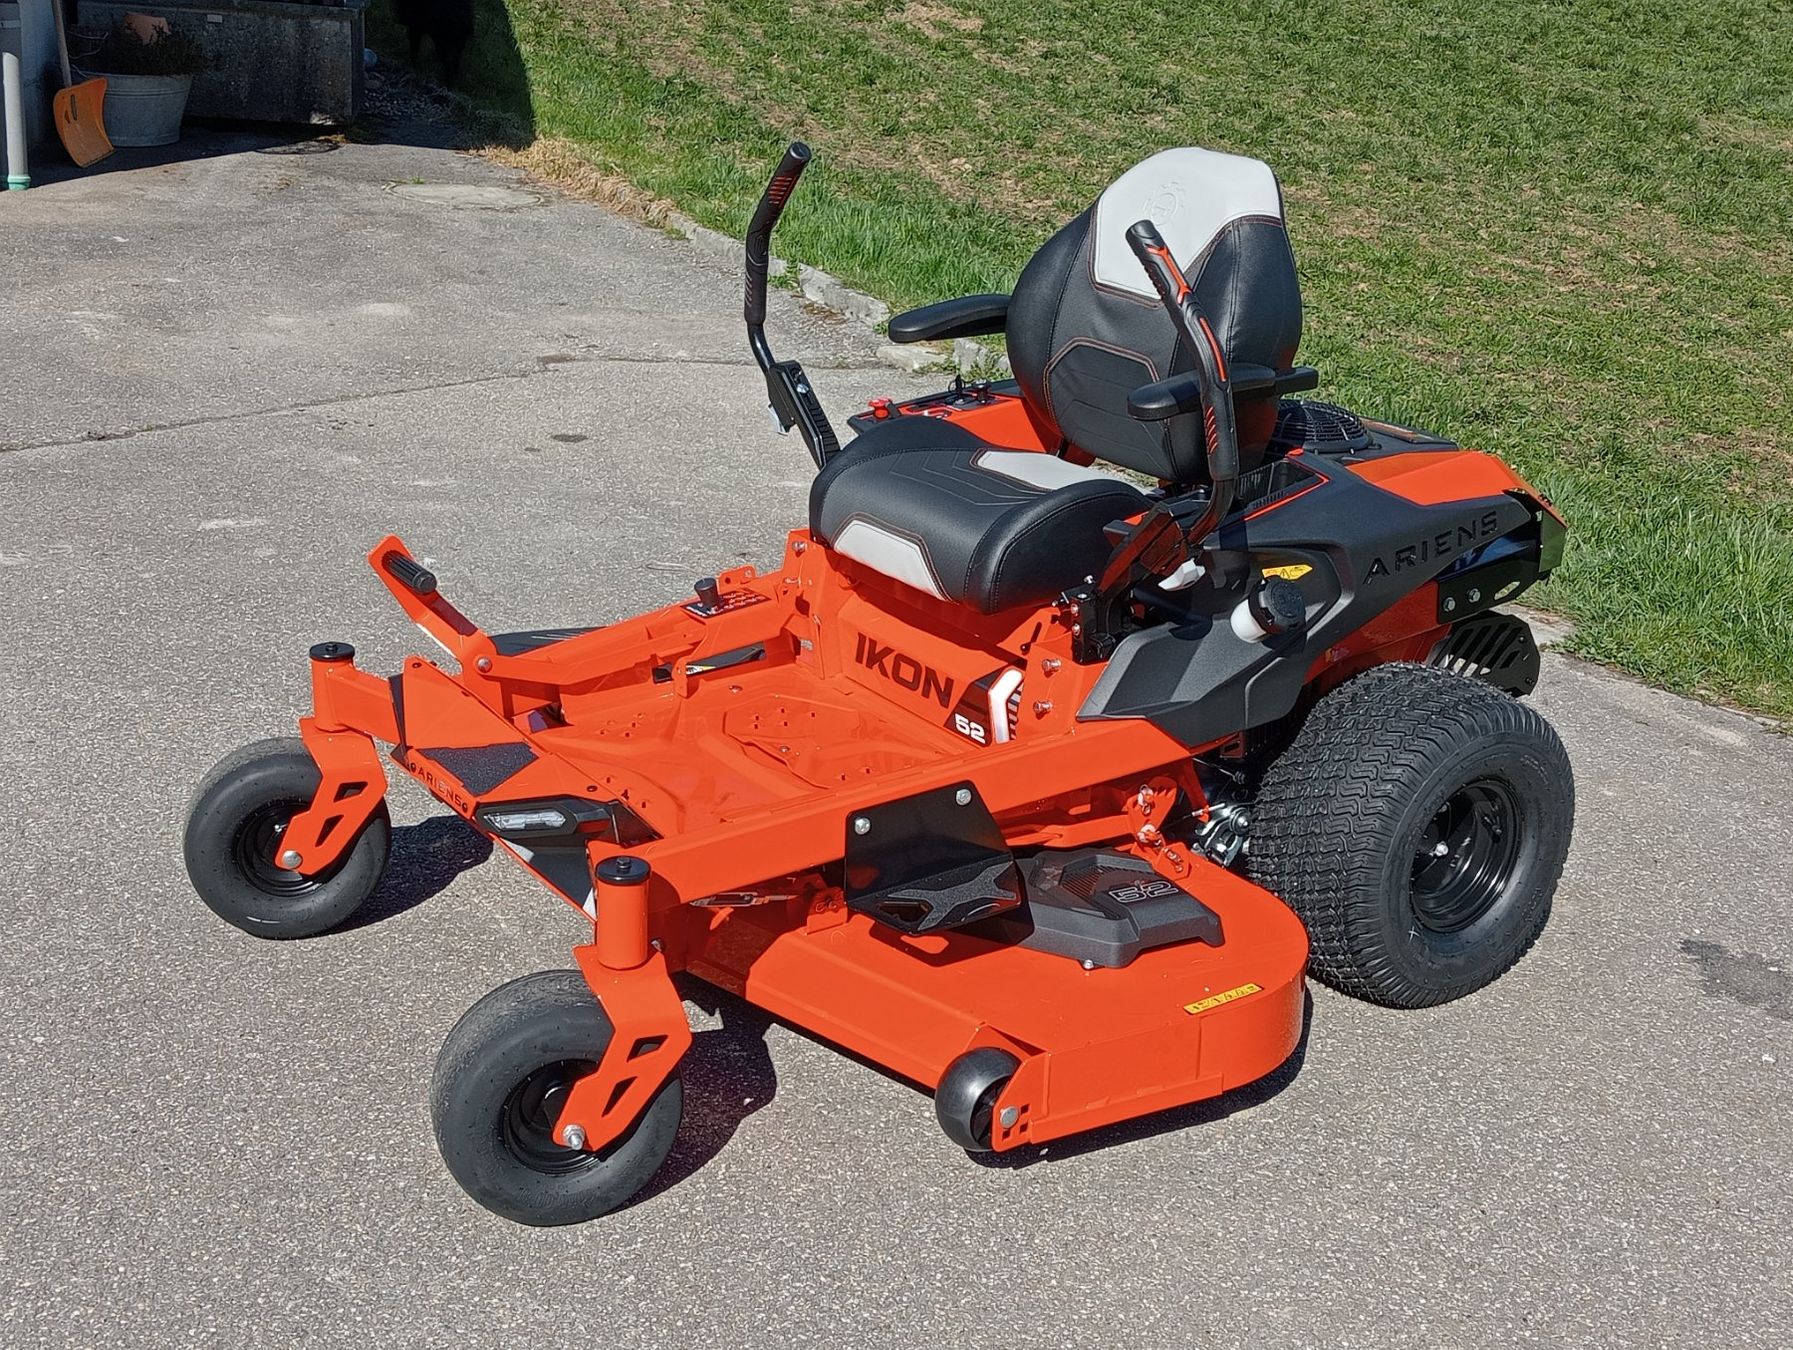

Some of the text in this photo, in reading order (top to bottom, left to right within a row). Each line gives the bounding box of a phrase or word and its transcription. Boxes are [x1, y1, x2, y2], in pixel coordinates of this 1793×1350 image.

[1363, 510, 1497, 585] ARIENS
[855, 632, 954, 709] IKON
[955, 713, 986, 744] 52
[418, 767, 463, 807] ARIENS
[1108, 880, 1179, 903] 52
